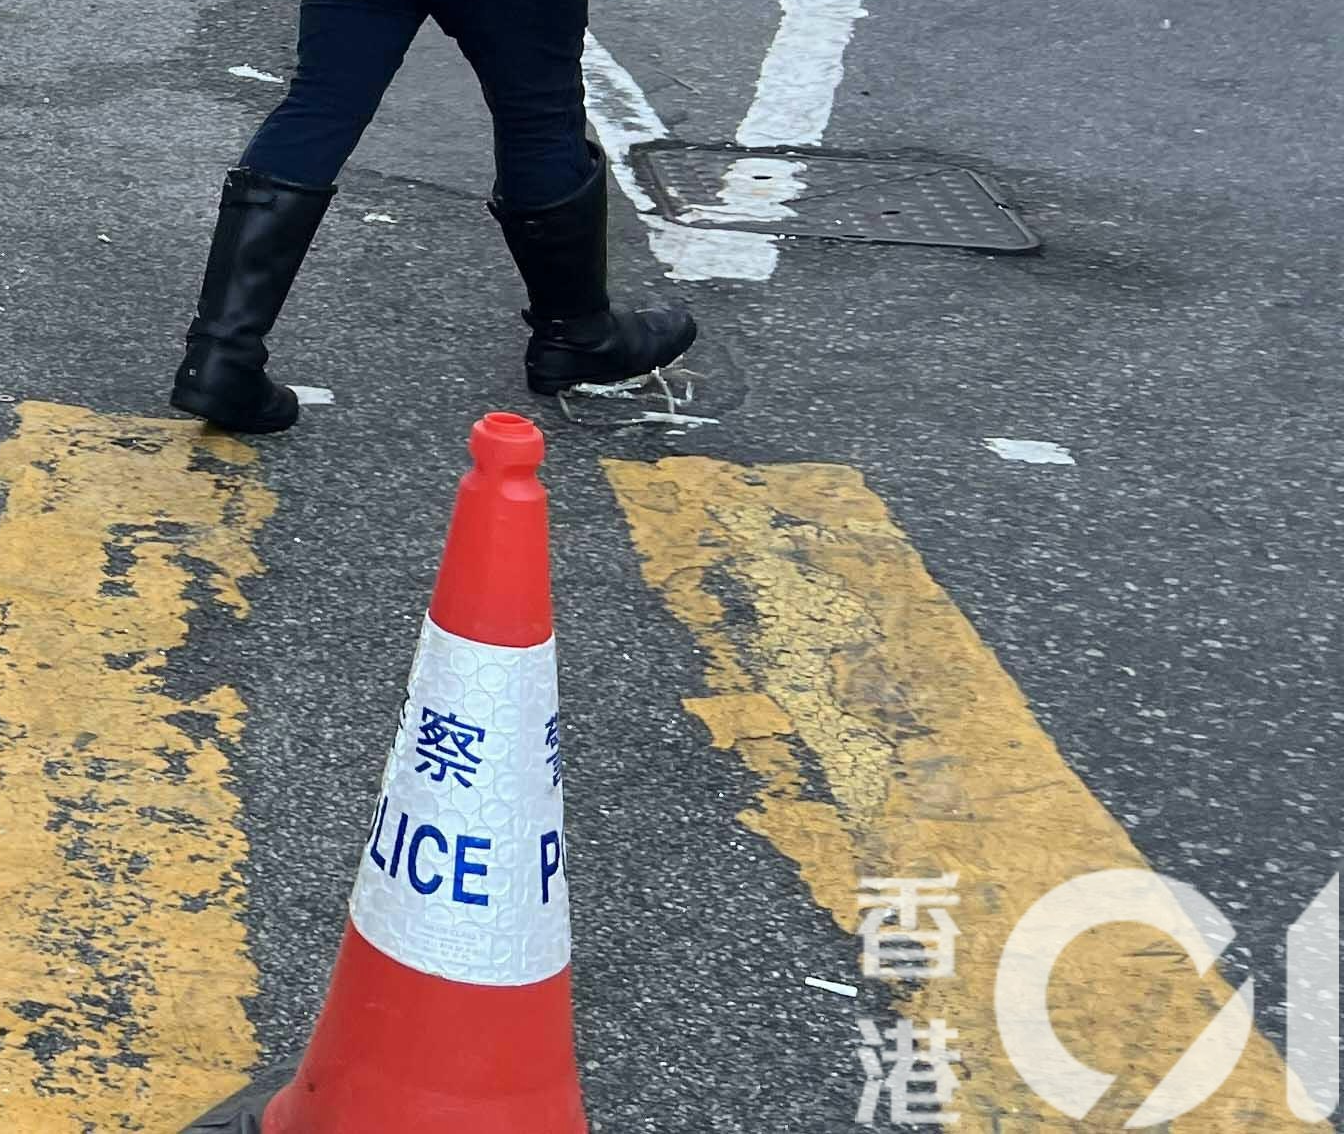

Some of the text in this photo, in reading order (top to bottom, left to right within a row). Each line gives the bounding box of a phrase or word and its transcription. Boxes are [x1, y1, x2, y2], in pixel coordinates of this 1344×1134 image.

[414, 706, 486, 788] 察
[367, 794, 567, 907] LICE P
